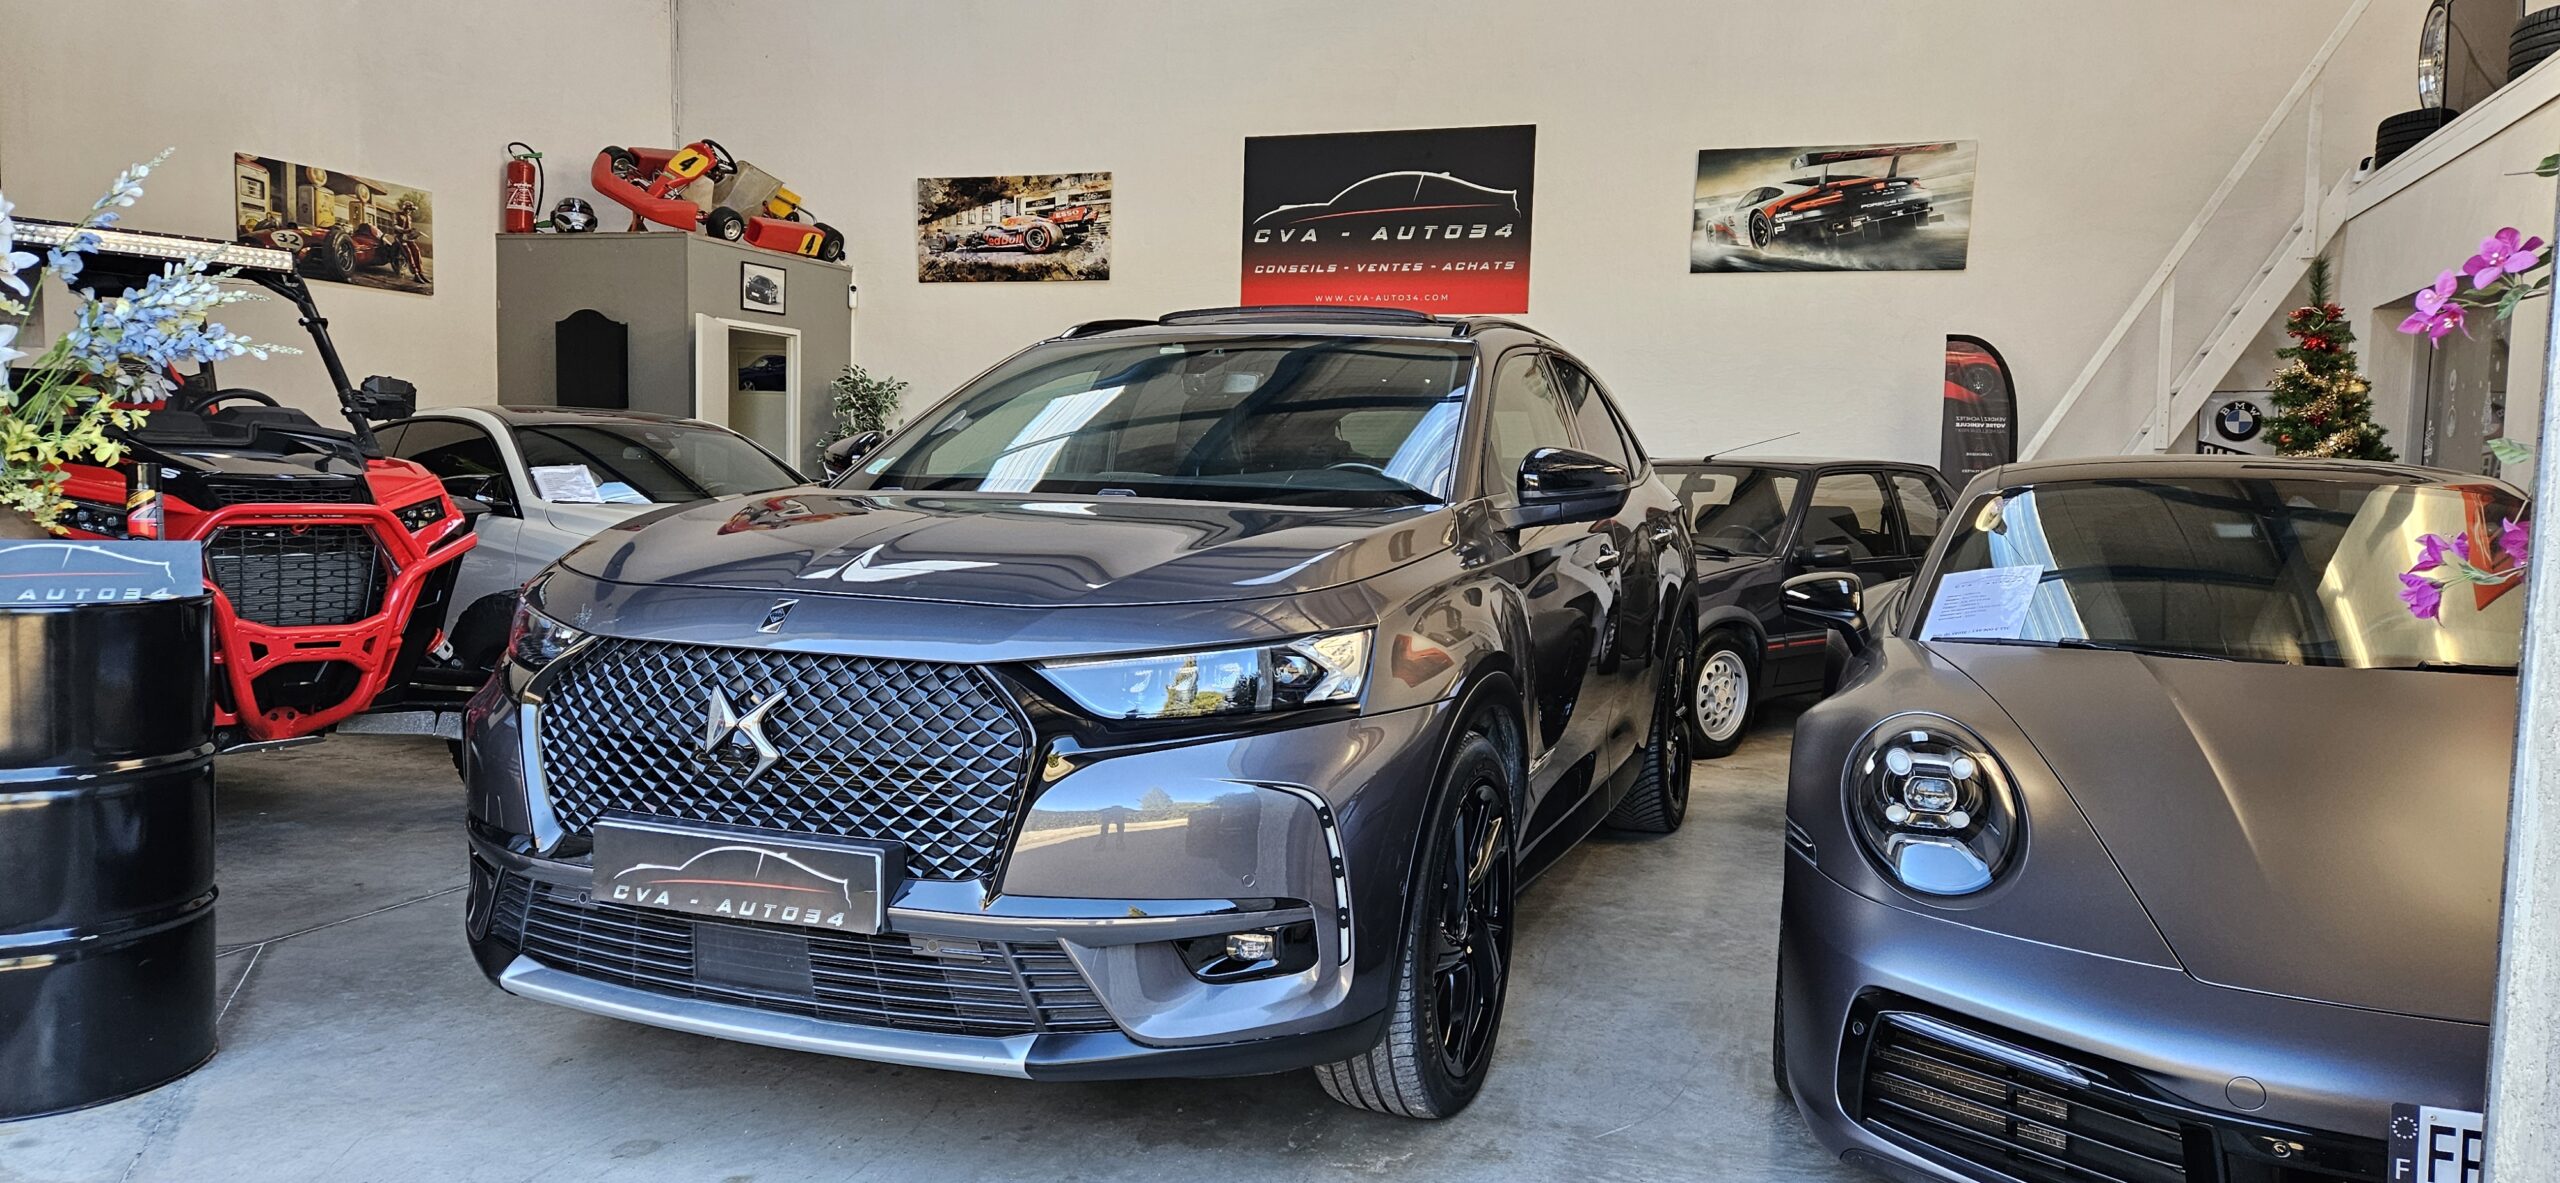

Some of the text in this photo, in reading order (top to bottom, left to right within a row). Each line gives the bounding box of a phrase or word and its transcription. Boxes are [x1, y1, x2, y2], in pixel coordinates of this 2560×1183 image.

[678, 156, 699, 172] 4
[1055, 210, 1080, 219] ESSO
[276, 232, 301, 247] 32
[1254, 228, 1318, 244] CVA
[1371, 223, 1514, 241] AUTO34
[805, 234, 816, 253] 4
[1254, 264, 1338, 274] CONSEILS
[1357, 262, 1424, 273] VENTES
[1442, 261, 1516, 272] ACHATS
[1314, 294, 1449, 303] WWW.CVA-AUTO34.COM
[2220, 402, 2261, 416] BMW
[17, 587, 170, 601] AUTO34
[613, 885, 670, 906] CVA
[716, 899, 845, 927] AUTO34
[2395, 1158, 2411, 1180] F
